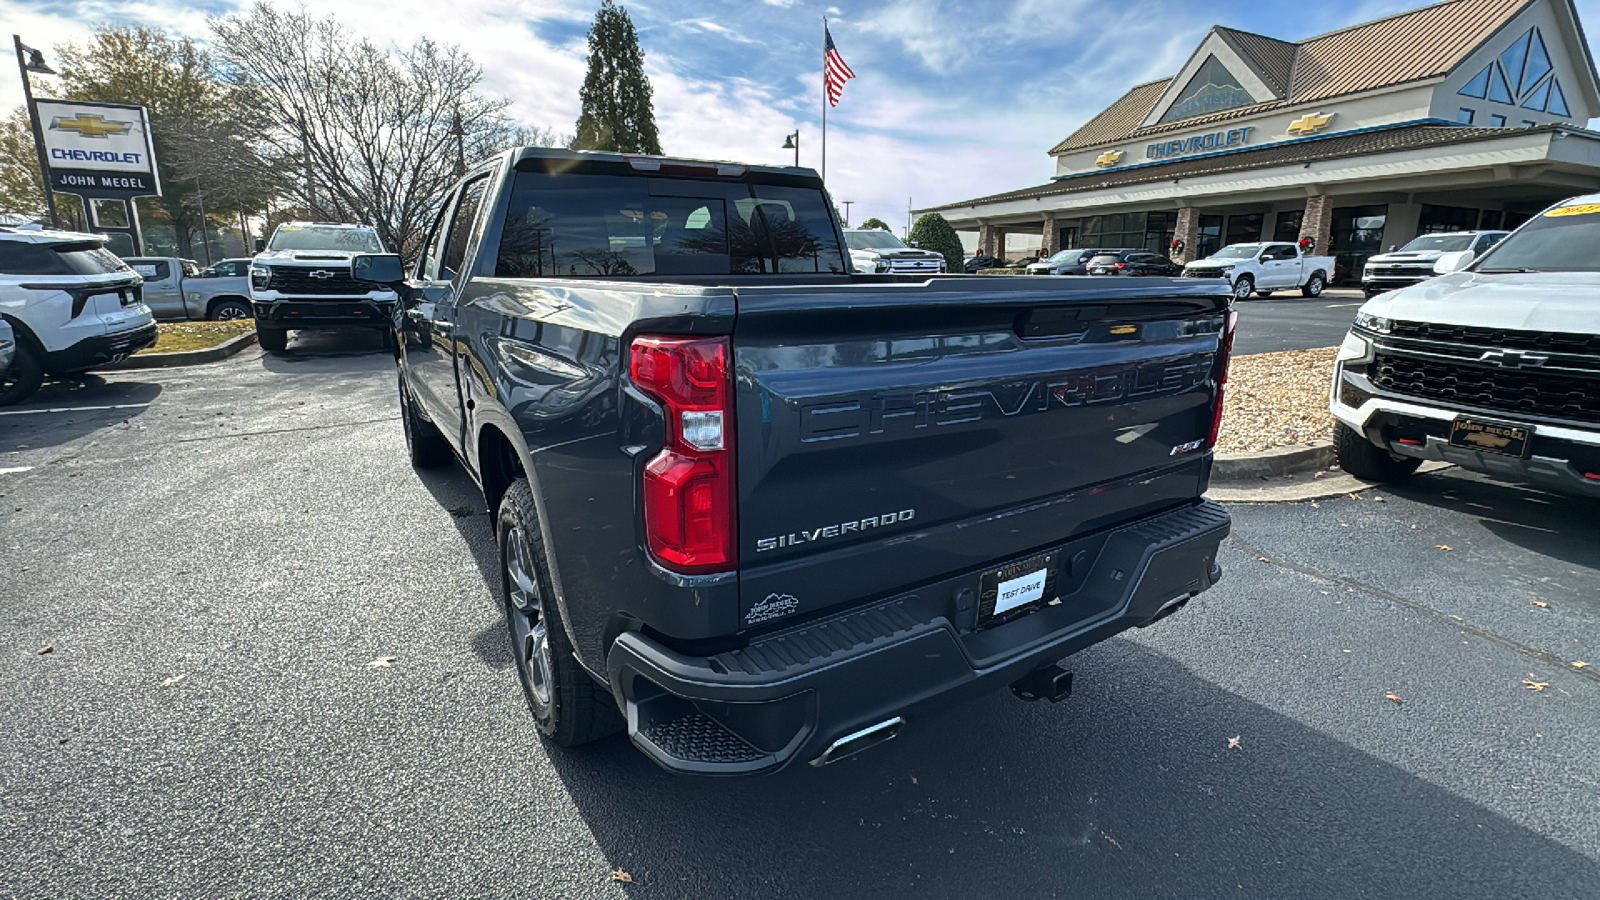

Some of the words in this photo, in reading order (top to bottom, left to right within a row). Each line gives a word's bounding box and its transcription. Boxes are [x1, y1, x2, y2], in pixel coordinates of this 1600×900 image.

[1146, 126, 1252, 159] CHEVROLET
[51, 148, 142, 164] CHEVROLET
[60, 175, 96, 186] JOHN
[101, 177, 146, 188] MEGEL
[800, 358, 1212, 443] CHEVROLET
[756, 508, 915, 552] SILVERADO
[1001, 588, 1020, 600] TEST
[1020, 581, 1042, 594] DRIVE
